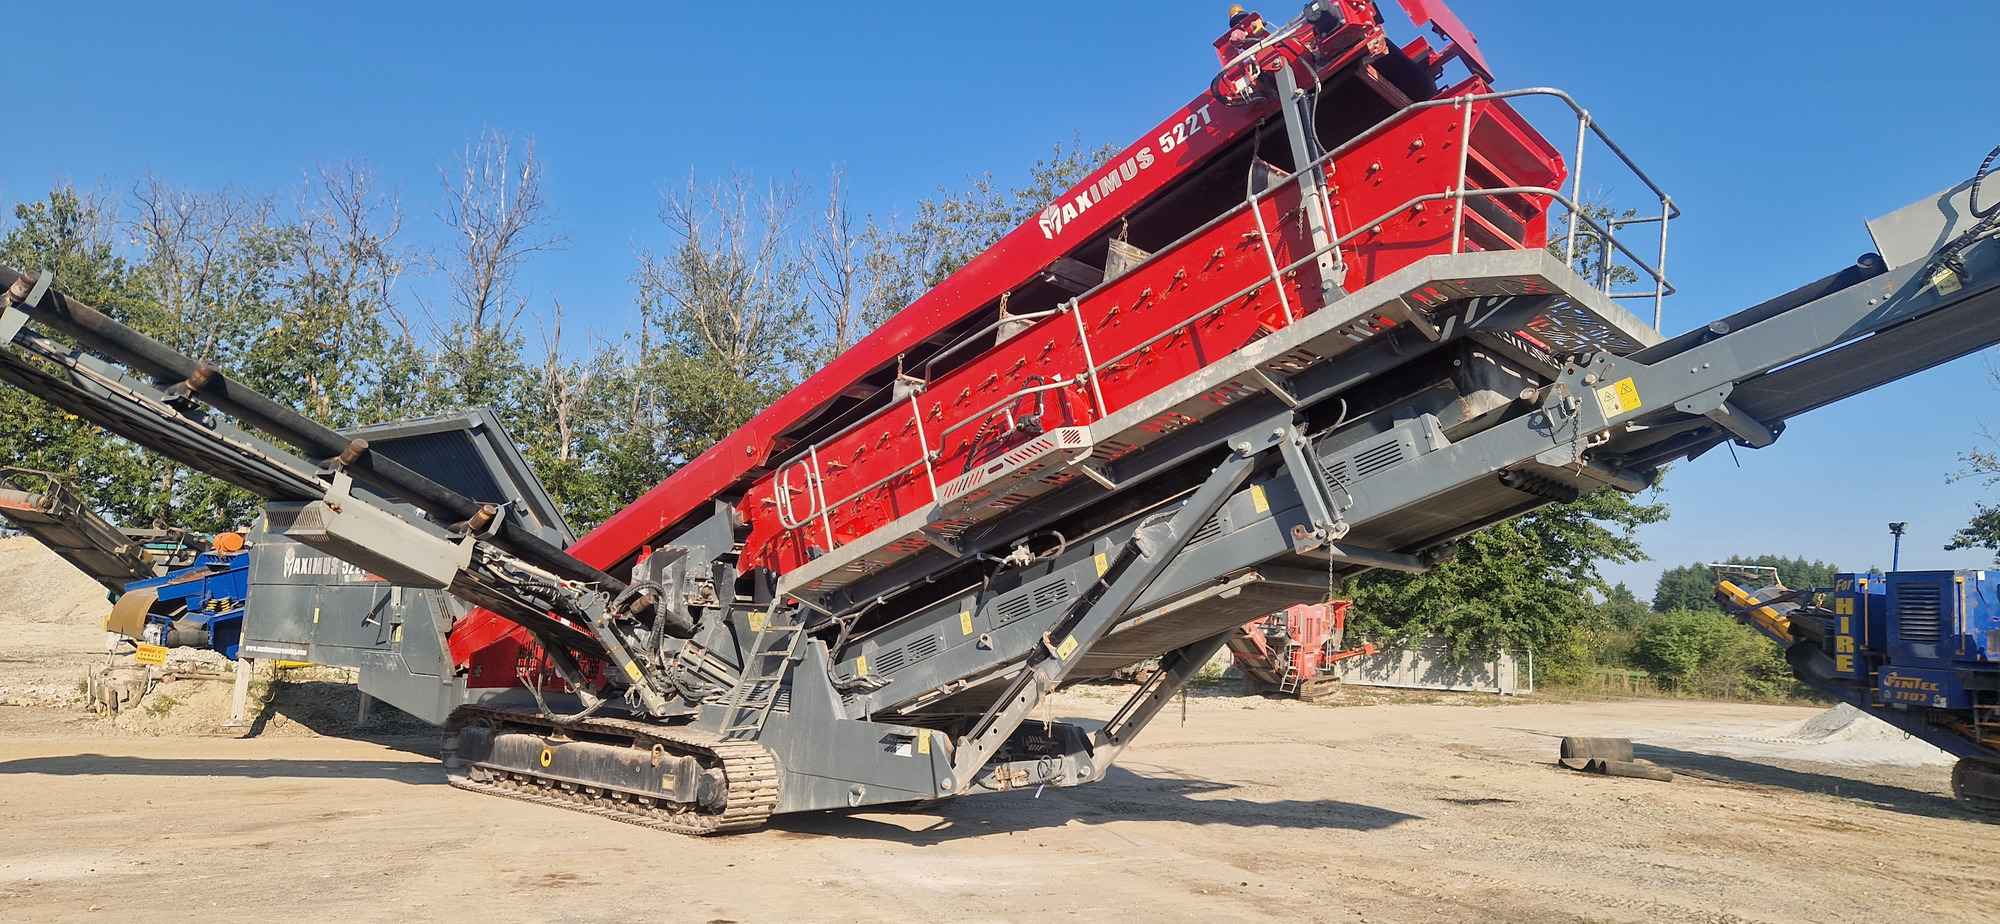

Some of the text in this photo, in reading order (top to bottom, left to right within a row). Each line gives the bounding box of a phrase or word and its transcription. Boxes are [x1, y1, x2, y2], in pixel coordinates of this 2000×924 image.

[1038, 103, 1212, 240] MAXIMUS 522T
[283, 546, 366, 579] MAXIMUS 52
[1836, 597, 1854, 673] HIRE
[1896, 691, 1928, 702] 1107
